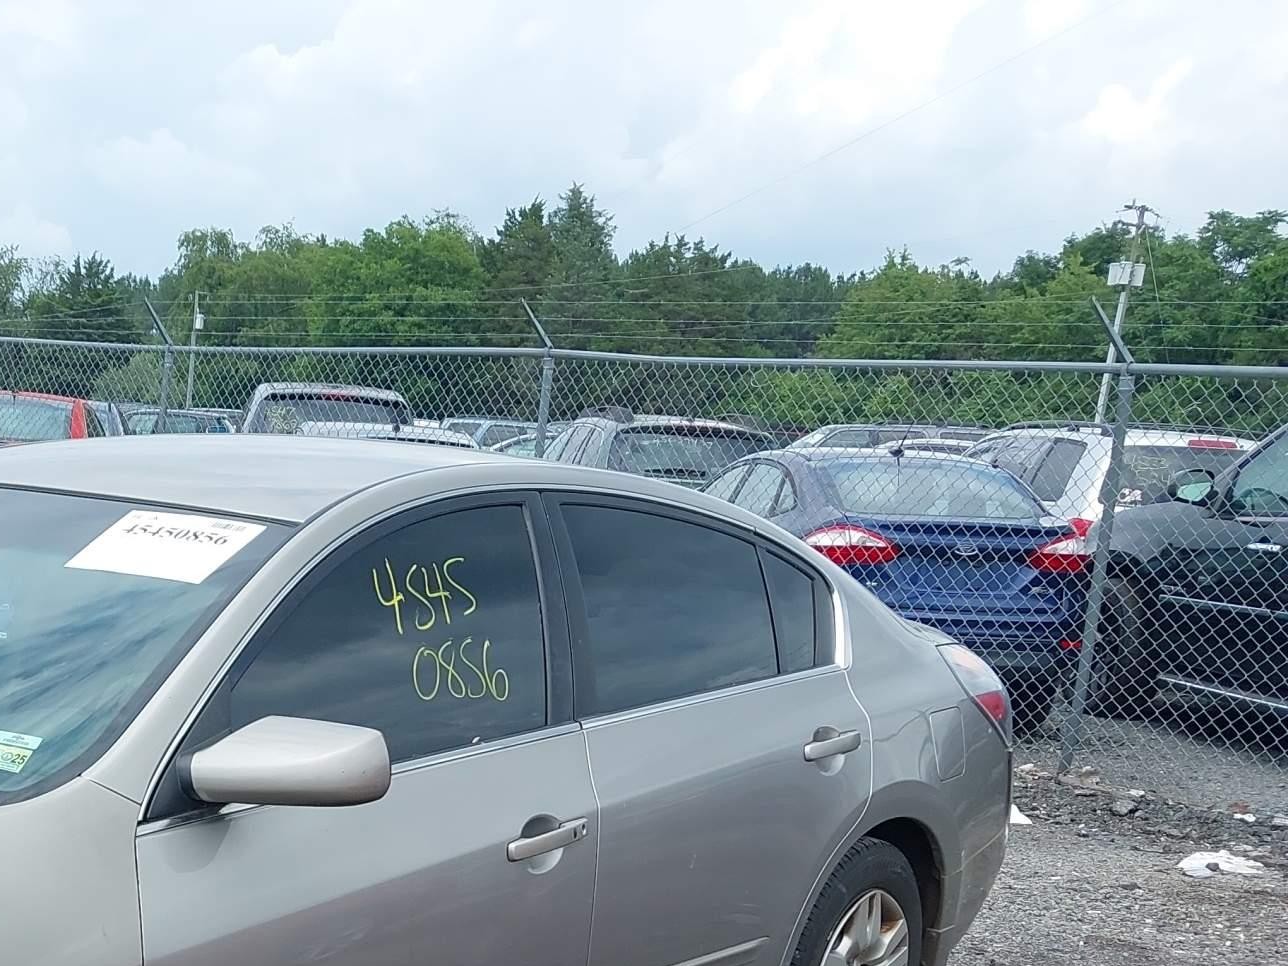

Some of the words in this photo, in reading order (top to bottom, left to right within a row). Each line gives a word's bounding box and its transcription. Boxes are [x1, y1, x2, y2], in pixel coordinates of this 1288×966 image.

[122, 523, 228, 546] 45450856
[372, 557, 478, 635] 4545
[412, 637, 509, 701] 0856
[11, 754, 28, 765] 25
